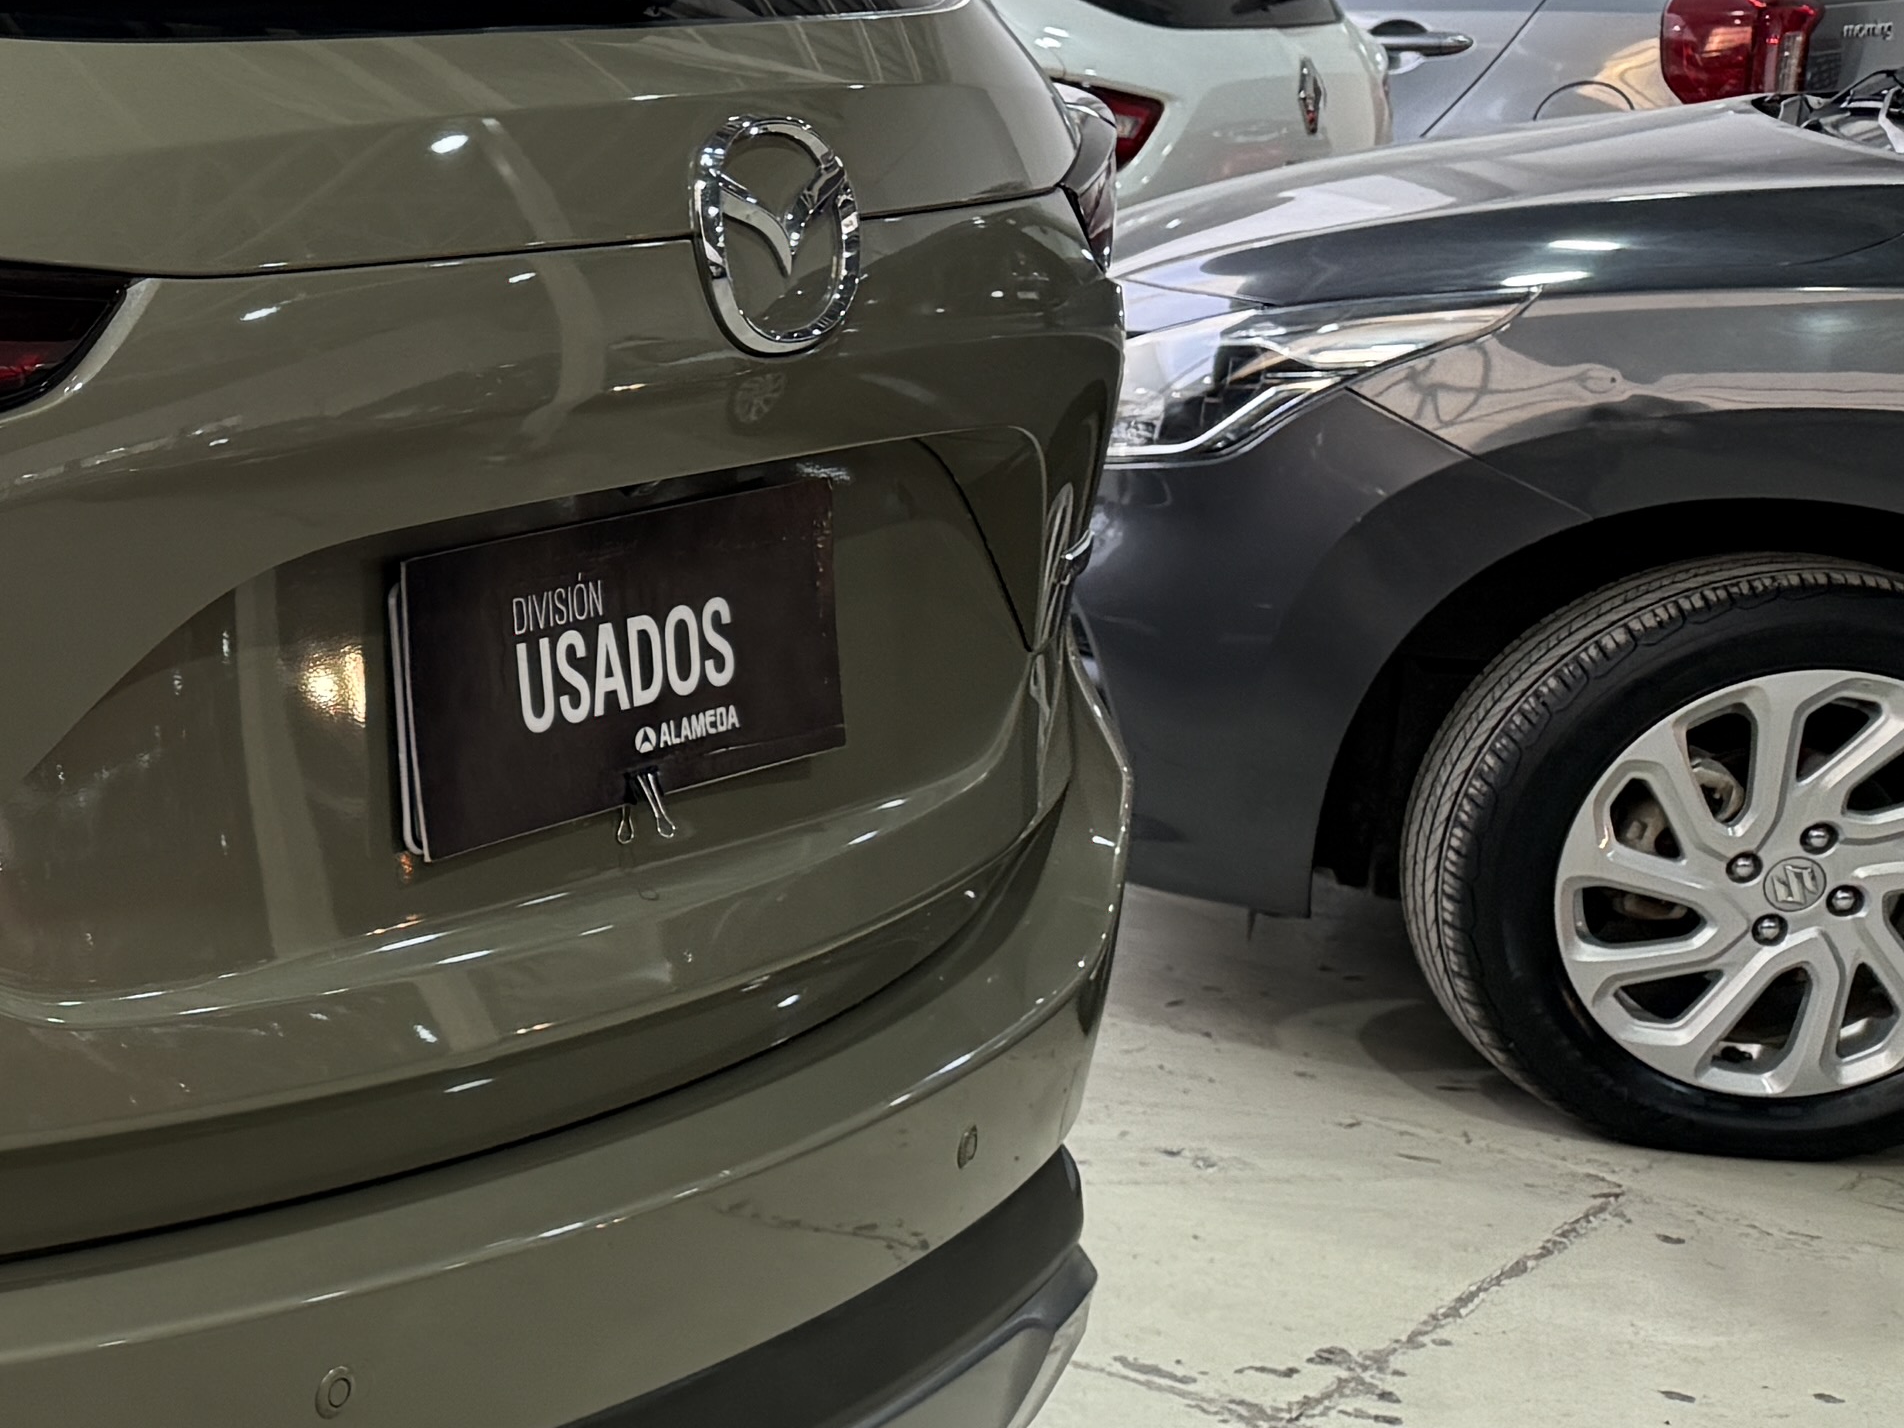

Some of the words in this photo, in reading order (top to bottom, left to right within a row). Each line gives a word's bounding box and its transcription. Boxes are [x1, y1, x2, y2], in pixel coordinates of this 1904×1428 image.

[512, 572, 604, 636] DIVISIÓN
[514, 596, 736, 735] USADOS
[658, 704, 741, 749] ALAMEDA
